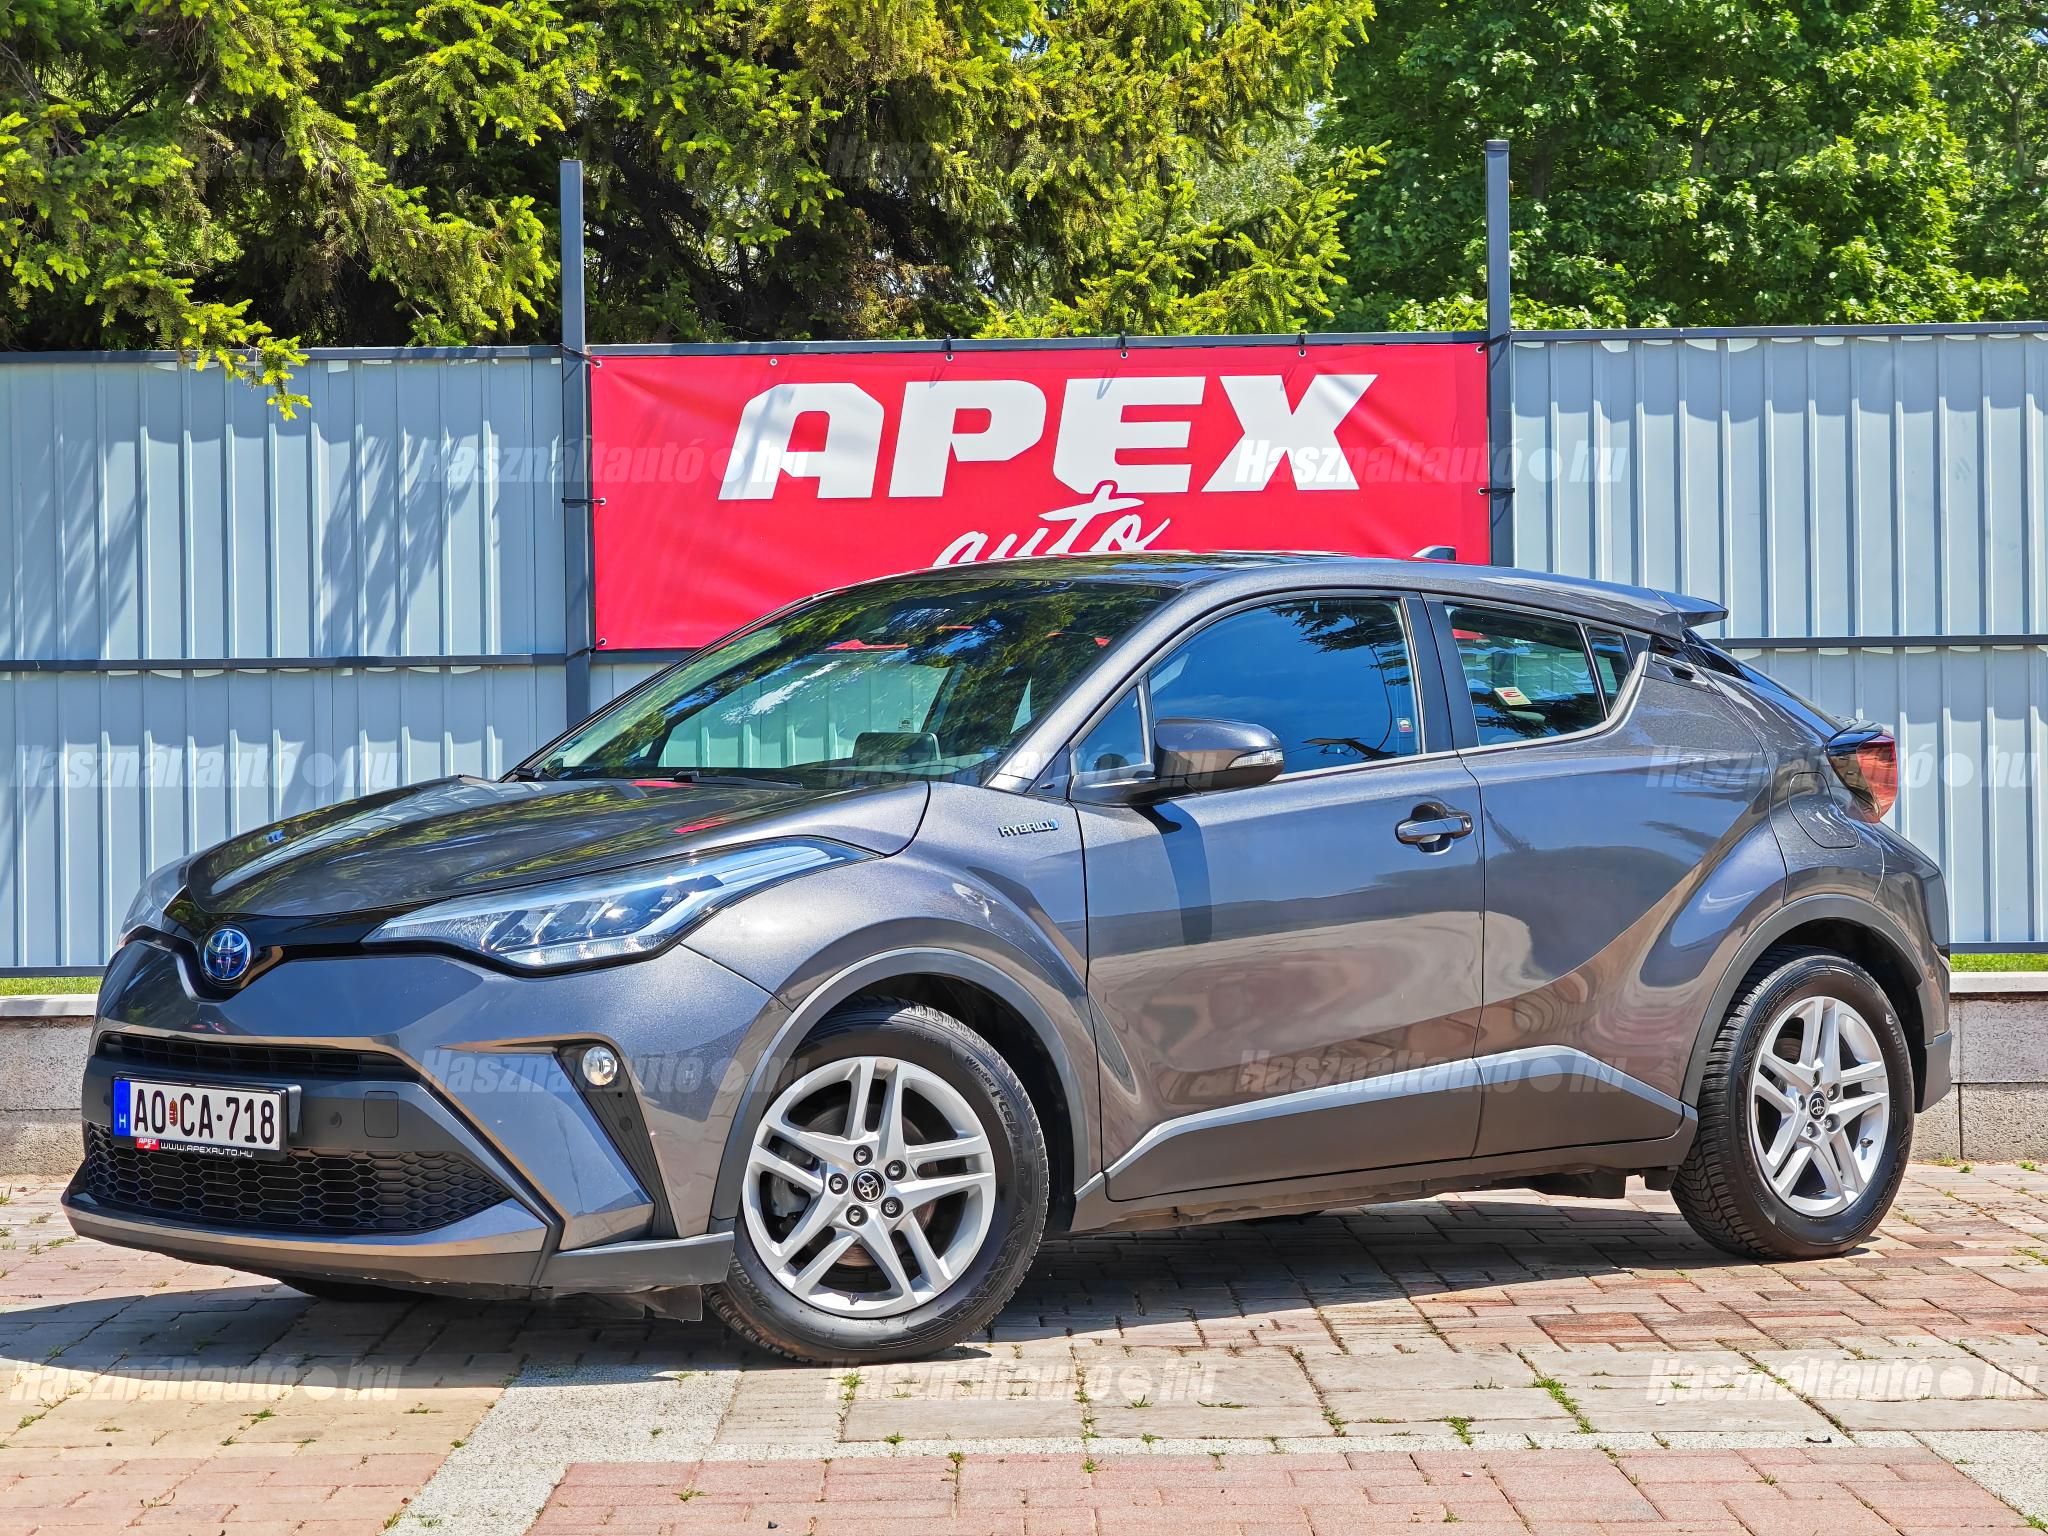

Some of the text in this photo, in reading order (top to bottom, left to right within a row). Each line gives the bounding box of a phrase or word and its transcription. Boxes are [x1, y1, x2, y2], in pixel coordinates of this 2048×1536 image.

[718, 374, 1377, 500] APEX
[932, 484, 1171, 566] auto
[998, 820, 1053, 837] HYBRID
[118, 1113, 127, 1128] H
[138, 1137, 157, 1145] APEX
[160, 1142, 254, 1158] WWW.APEXAUTO.HU
